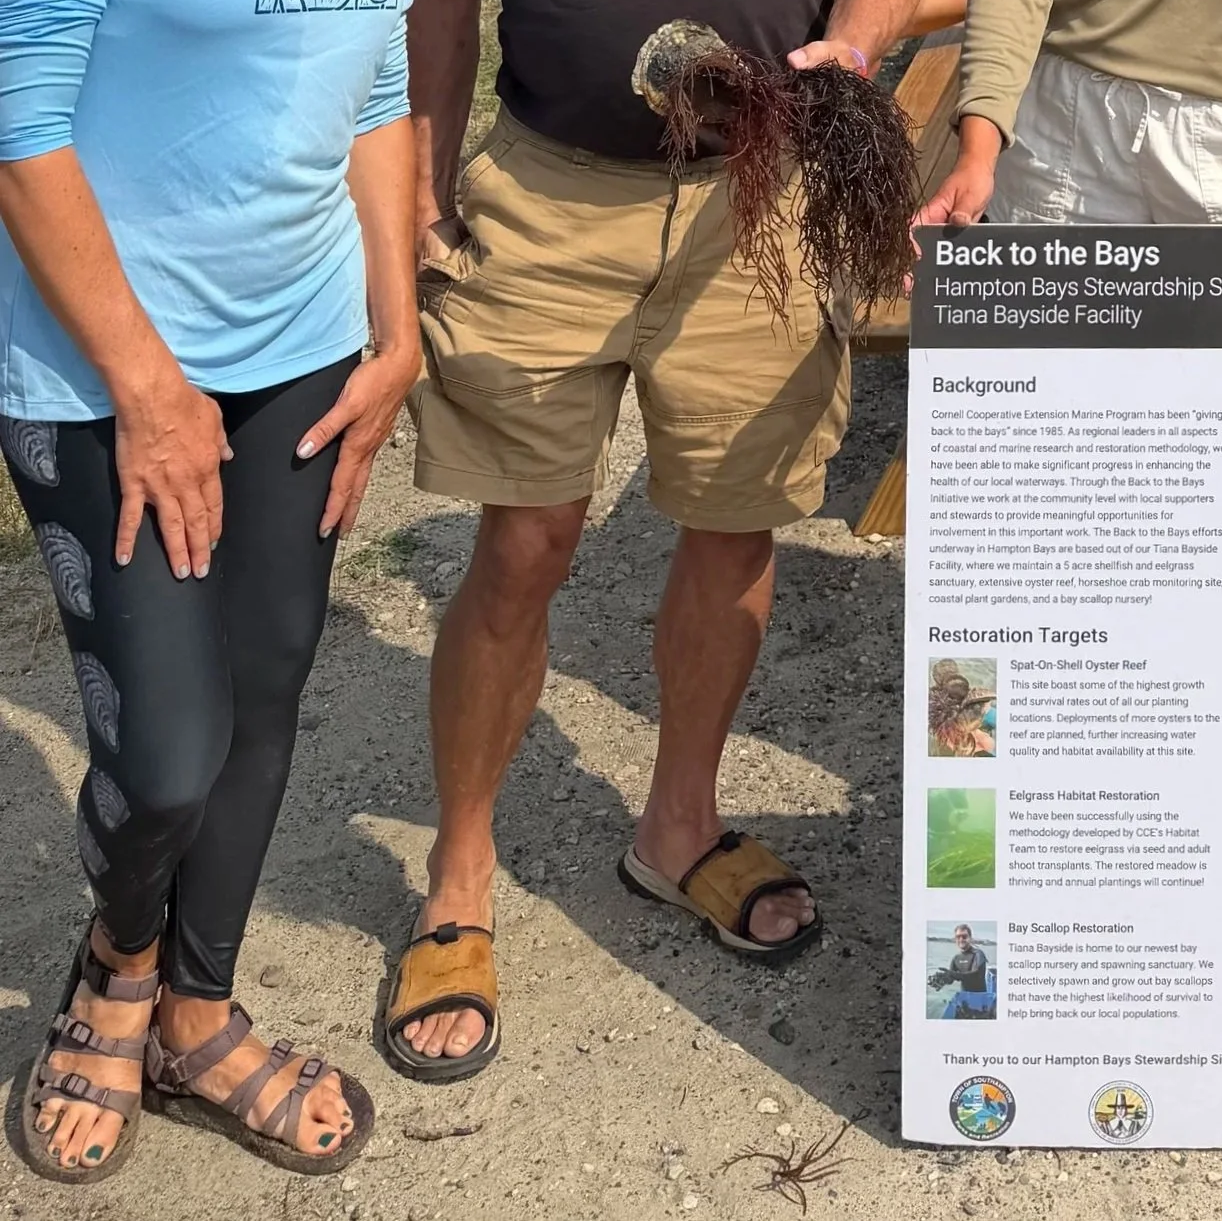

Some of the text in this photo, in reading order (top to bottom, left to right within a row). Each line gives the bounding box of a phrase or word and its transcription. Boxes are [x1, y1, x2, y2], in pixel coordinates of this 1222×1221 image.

[935, 238, 1160, 269] Back to the Bays
[935, 277, 1026, 300] Hampton
[1032, 277, 1078, 300] Bays
[1083, 276, 1204, 300] Stewardship
[933, 304, 1142, 328] Tiana Bayside Facility
[932, 376, 1036, 397] Background
[931, 409, 964, 419] Cornell
[965, 409, 1022, 421] Cooperative
[1023, 409, 1069, 419] Extension
[1071, 409, 1104, 419] Marine
[1105, 409, 1146, 421] Program
[1147, 409, 1165, 419] has
[1166, 409, 1190, 419] been
[930, 442, 941, 452] of
[942, 443, 977, 453] coastal
[978, 443, 997, 452] and
[998, 444, 1031, 452] marine
[1032, 443, 1073, 452] research
[1075, 443, 1093, 452] and
[1095, 444, 1146, 453] restoration
[1147, 443, 1210, 455] methodology,
[928, 593, 1152, 605] coastal plant gardens, and a bay scallop nursery!
[928, 626, 1108, 647] Restoration Targets
[1010, 659, 1147, 672] Spat-On-Shell Oyster Reef
[1010, 679, 1205, 691] This site boast some of the highest growth
[1009, 746, 1195, 758] quality and habitat availability at this site.
[1008, 790, 1160, 802] Eelgrass Habitat Restoration
[1008, 827, 1199, 839] methodology developed by CCE's Habitat
[1008, 876, 1204, 888] thriving and annual plantings will continue!
[1008, 922, 1134, 935] Bay Scallop Restoration
[1007, 976, 1213, 987] selectively spawn and grow out bay scallops
[942, 1053, 980, 1064] Thank
[982, 1056, 1004, 1067] you
[1006, 1054, 1019, 1064] to
[1021, 1056, 1042, 1064] our
[1044, 1054, 1100, 1067] Hampton
[1102, 1054, 1131, 1067] Bays
[1134, 1054, 1208, 1067] Stewardship
